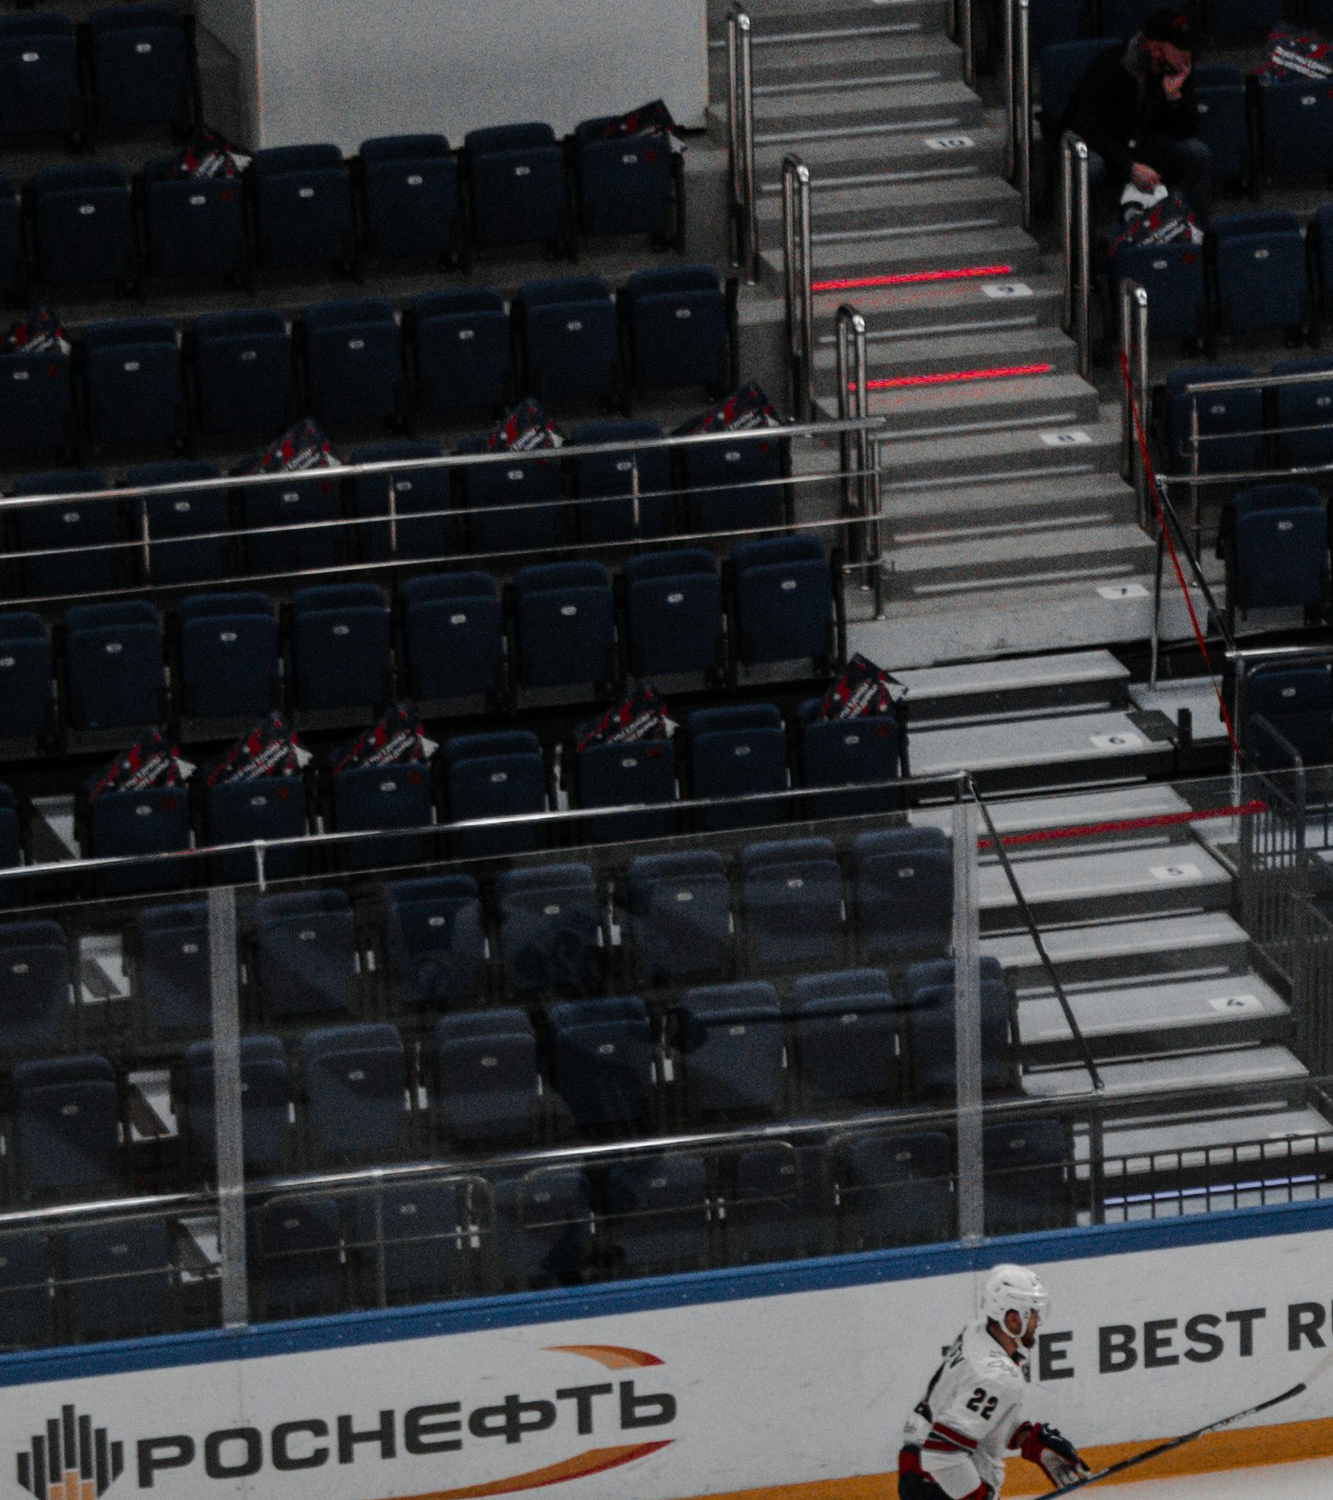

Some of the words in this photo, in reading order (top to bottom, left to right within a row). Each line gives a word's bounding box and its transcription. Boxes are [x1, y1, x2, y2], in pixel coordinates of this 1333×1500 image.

[1099, 1308, 1266, 1375] BEST
[137, 1380, 678, 1488] РОСНЕФТЬ
[966, 1387, 998, 1421] 22
